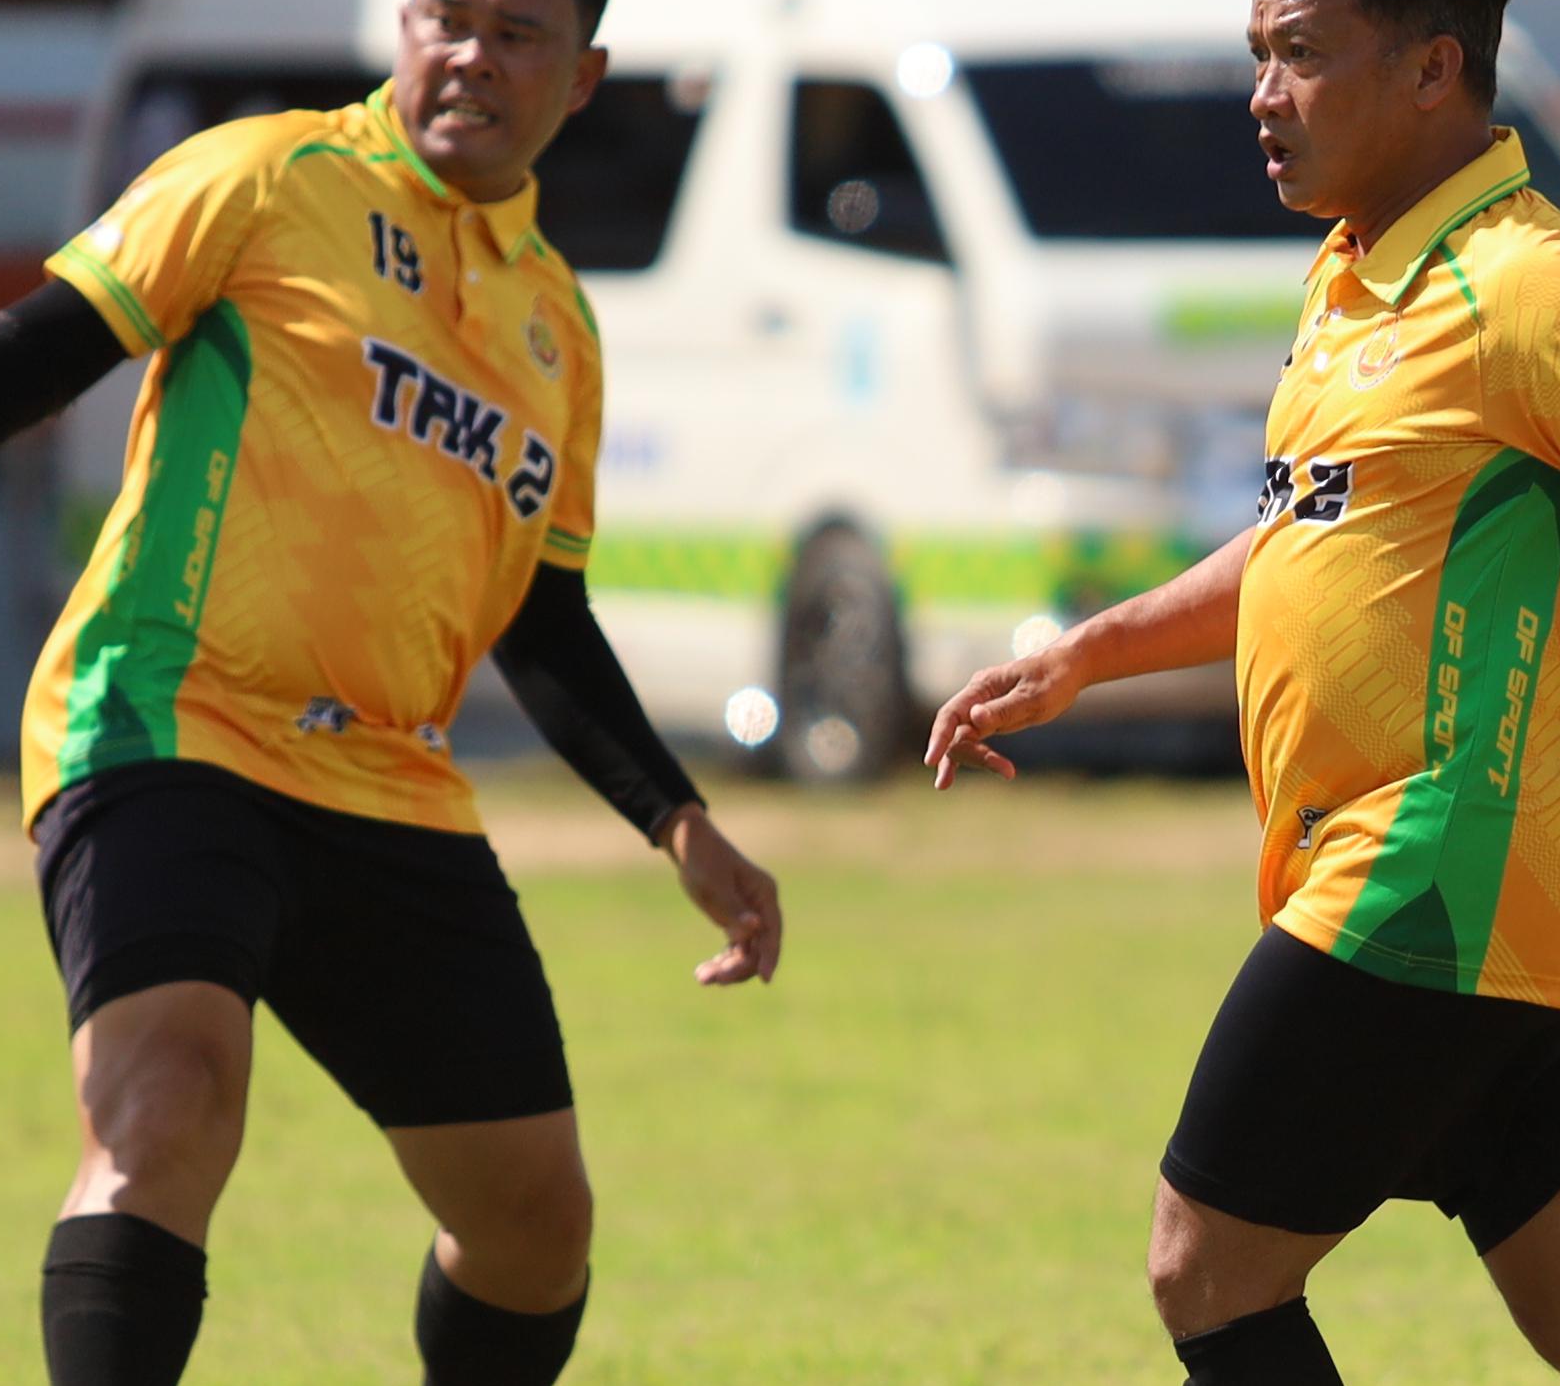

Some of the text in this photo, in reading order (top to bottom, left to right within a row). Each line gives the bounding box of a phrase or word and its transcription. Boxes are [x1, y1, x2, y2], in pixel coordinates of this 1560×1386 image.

[368, 210, 422, 293] 19
[503, 429, 558, 521] 2
[1293, 458, 1356, 523] 2
[1443, 600, 1467, 659] OF
[1487, 605, 1539, 798] OF SPORT
